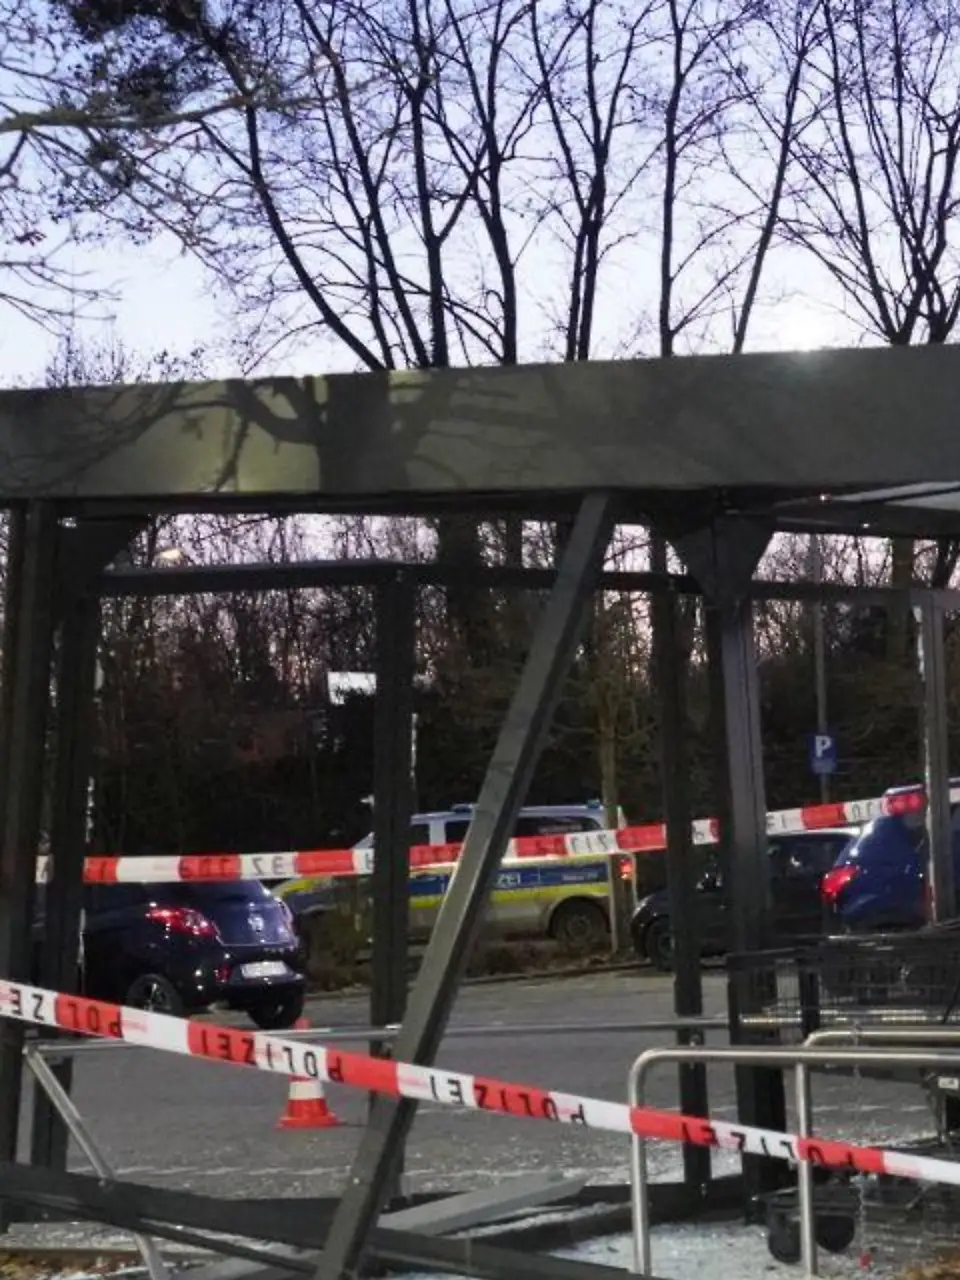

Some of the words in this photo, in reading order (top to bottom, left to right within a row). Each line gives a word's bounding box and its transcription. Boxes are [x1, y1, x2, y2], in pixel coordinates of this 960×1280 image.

[815, 735, 832, 758] P
[0, 987, 122, 1038] POLIZE
[200, 1029, 345, 1083] POLIZEI
[429, 1075, 588, 1127] POLIZEI
